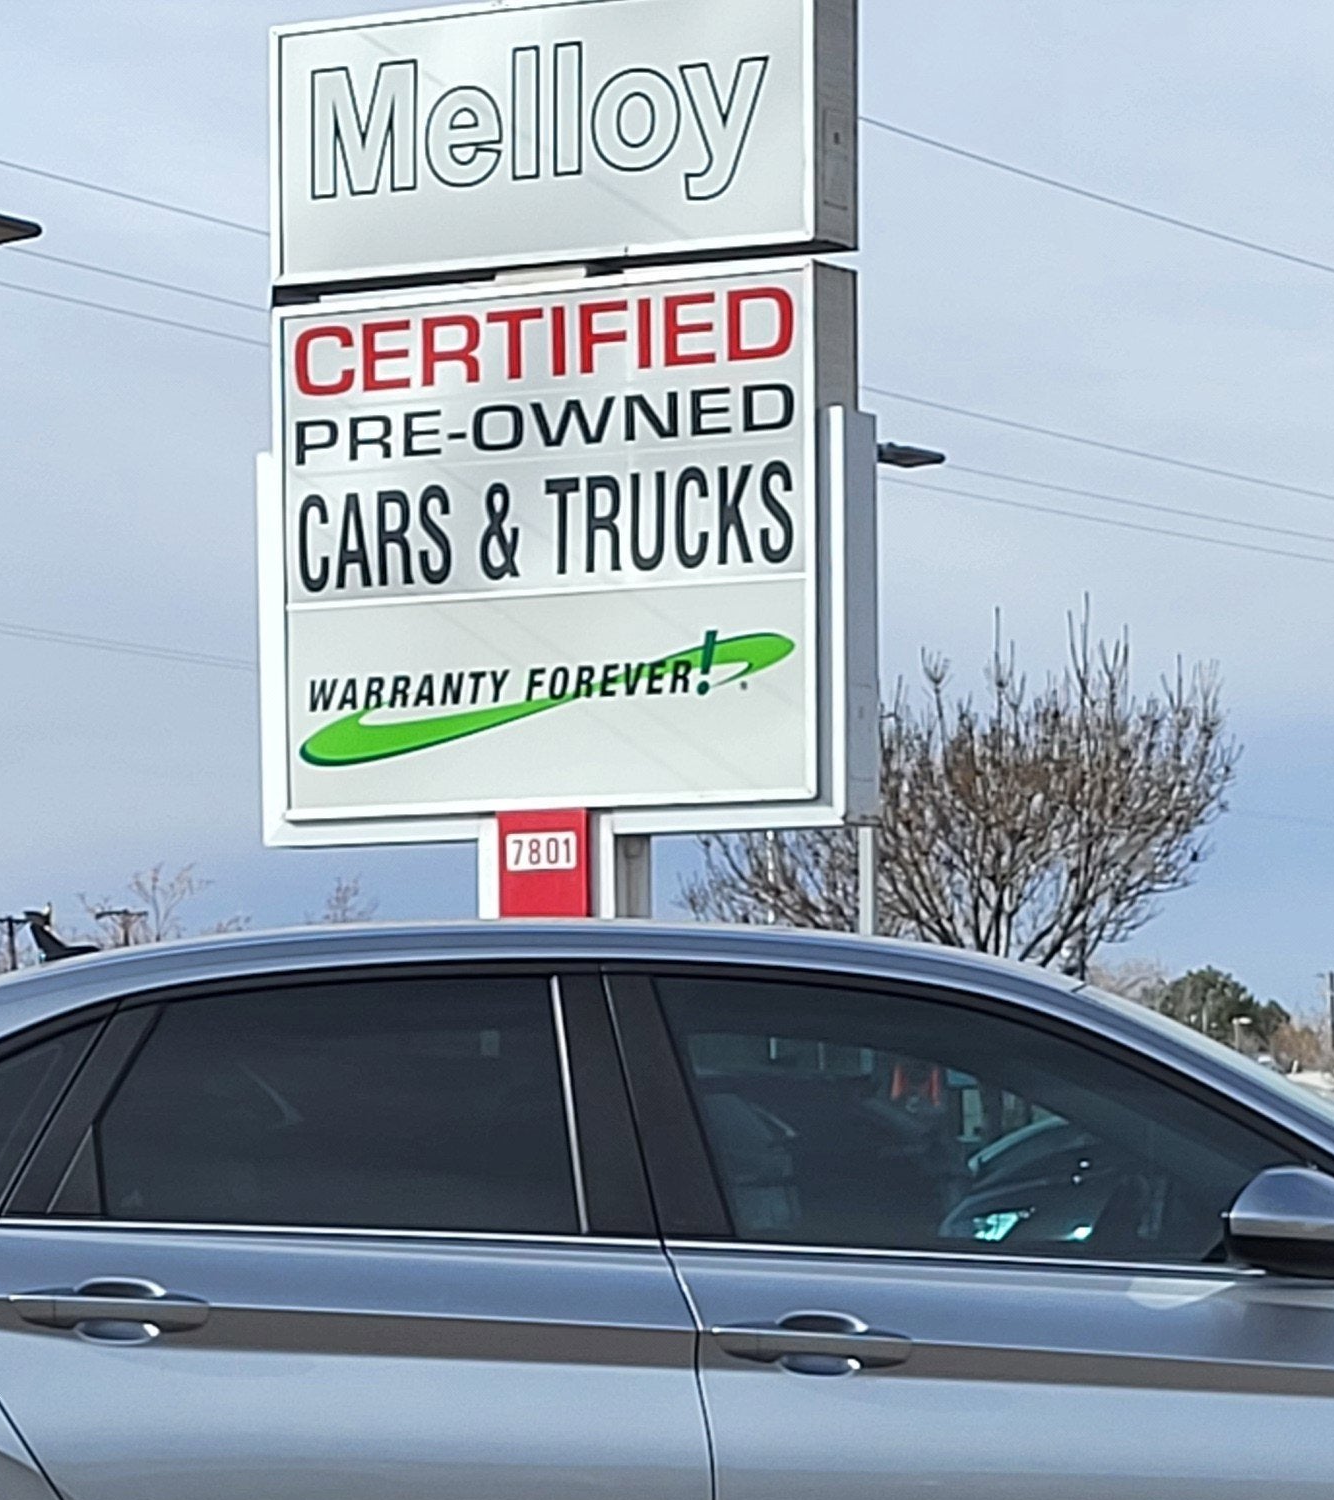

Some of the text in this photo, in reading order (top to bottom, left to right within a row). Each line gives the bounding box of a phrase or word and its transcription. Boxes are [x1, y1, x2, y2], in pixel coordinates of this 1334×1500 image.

[310, 41, 770, 202] Melloy
[294, 286, 795, 396] CERTIFIED
[294, 383, 795, 466] PRE-OWNED
[298, 460, 795, 593] CARS & TRUCKS
[308, 630, 719, 712] WARRANTY FOREVER!
[511, 836, 572, 866] 7801
